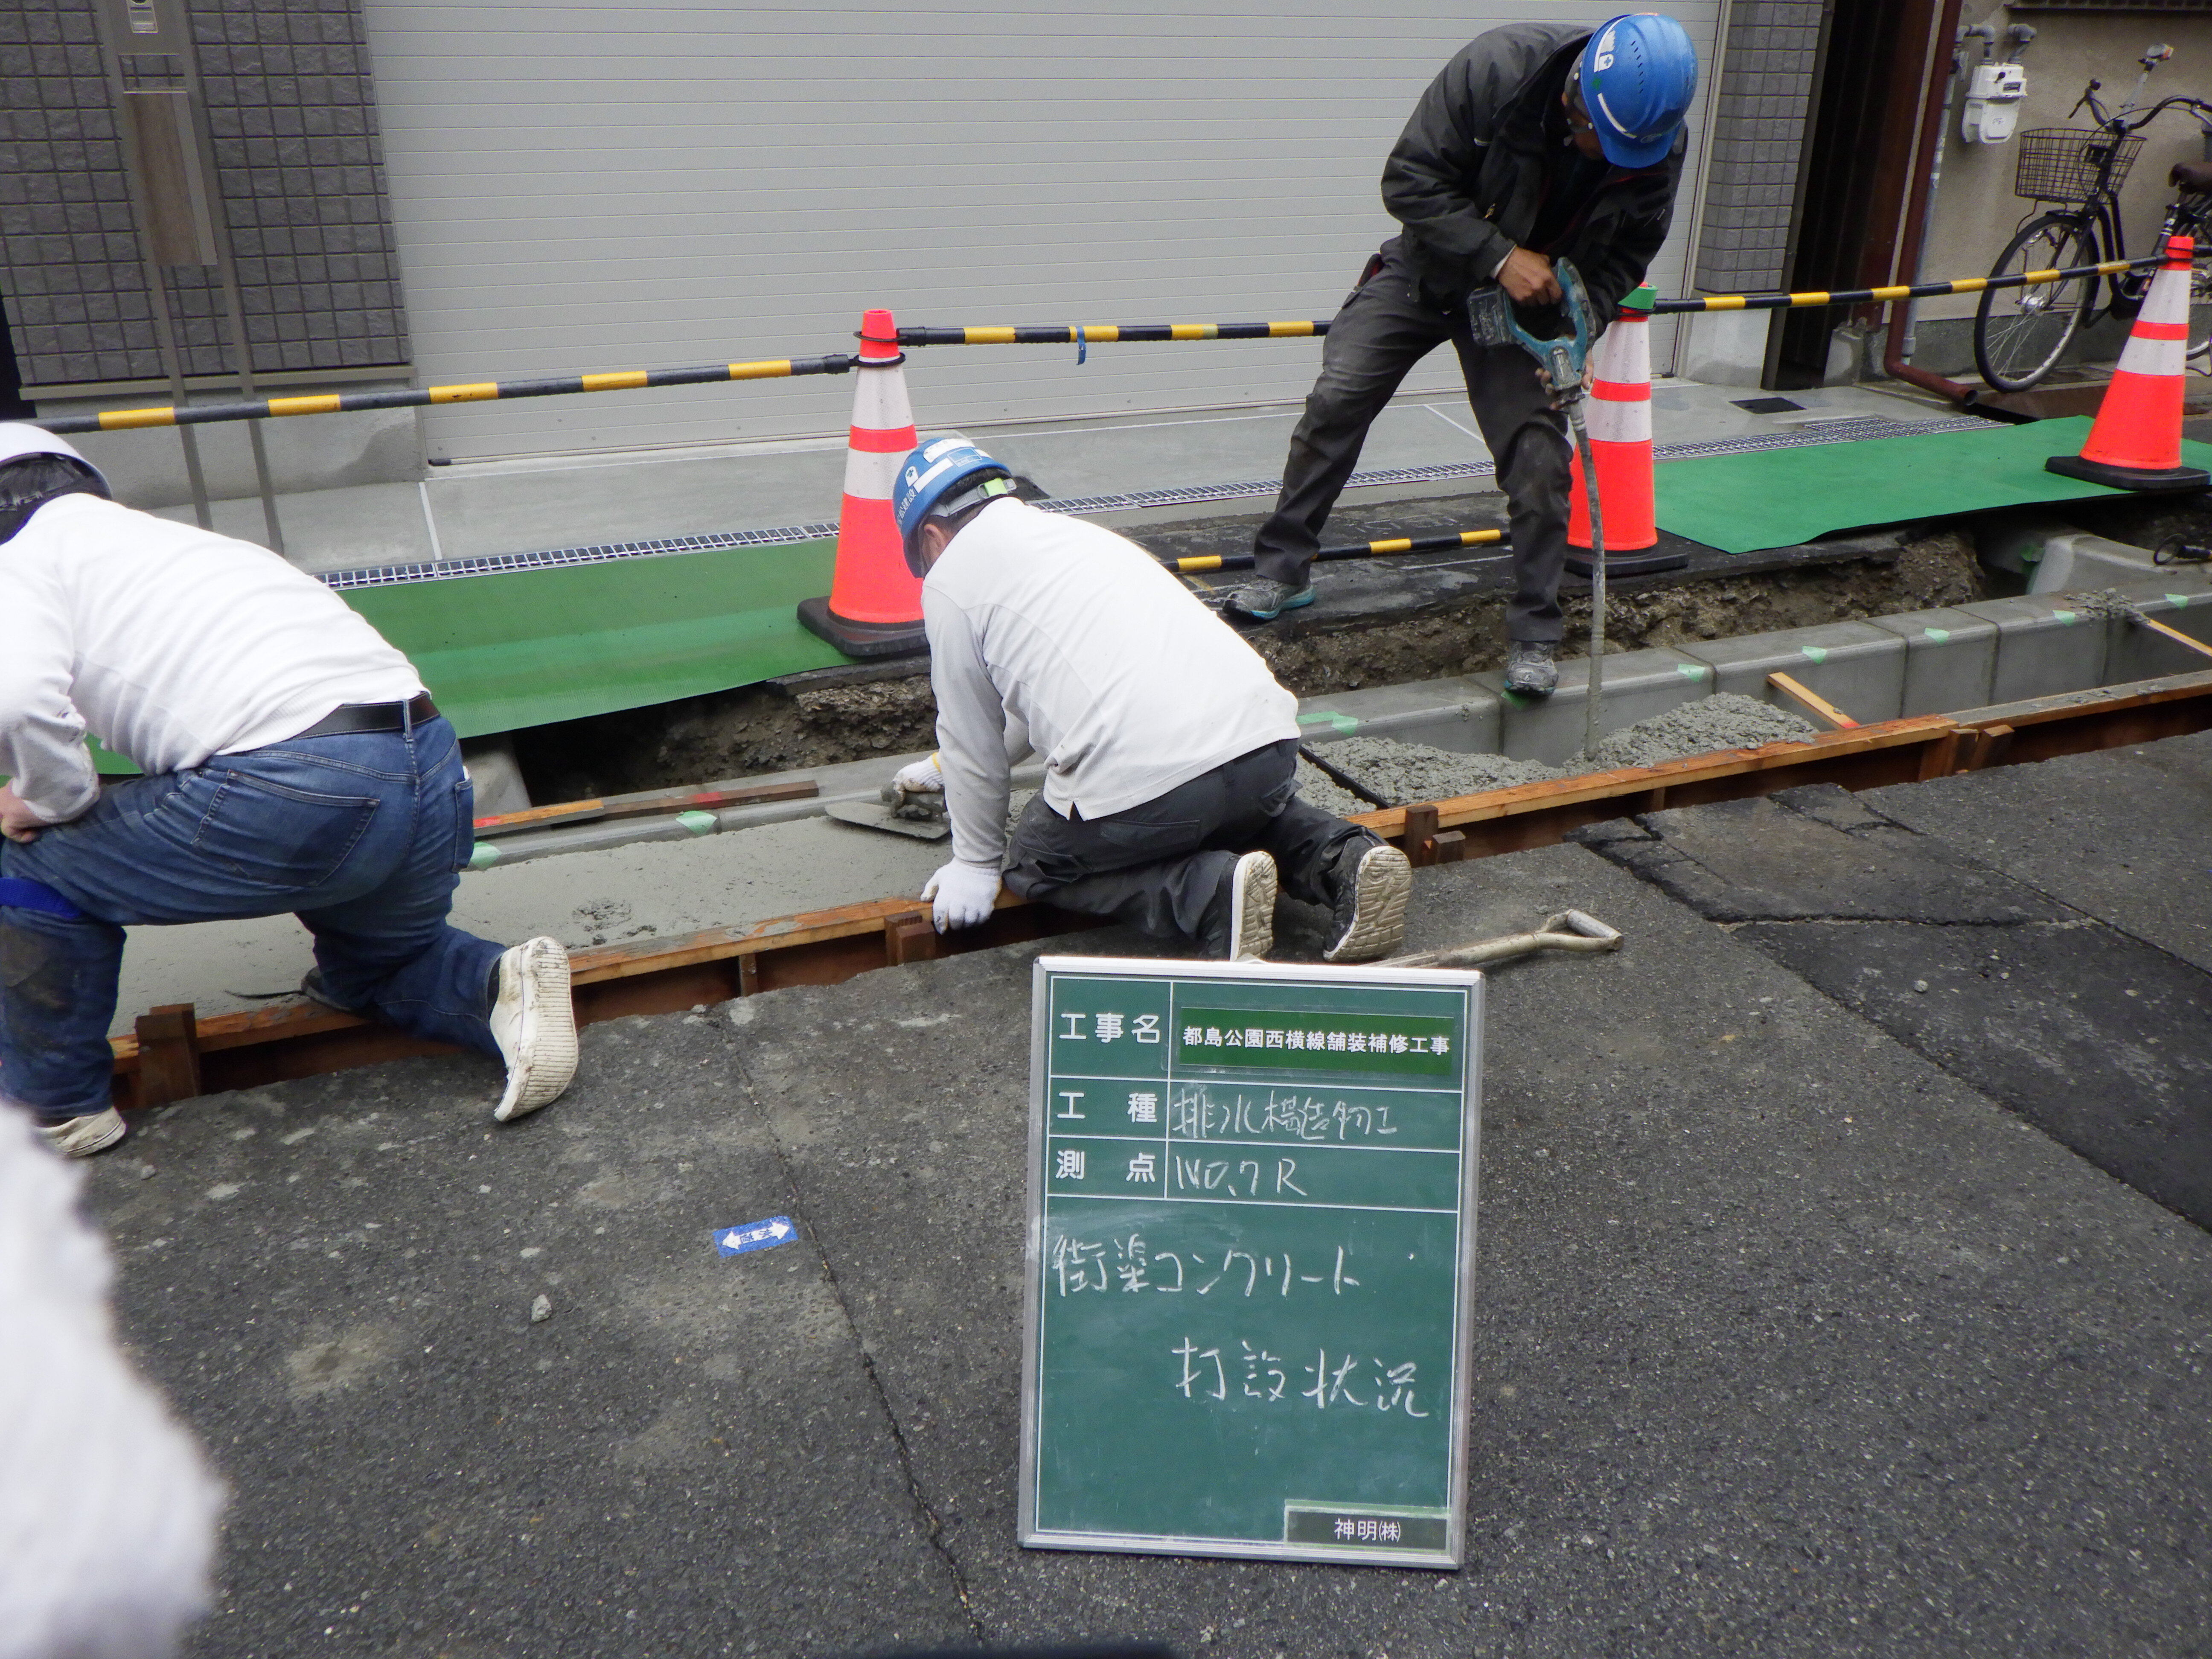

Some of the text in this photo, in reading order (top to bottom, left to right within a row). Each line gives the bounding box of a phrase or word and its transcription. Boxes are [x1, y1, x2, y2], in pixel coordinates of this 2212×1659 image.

[1059, 1013, 1160, 1043] 工事名
[1183, 1026, 1449, 1055] 都島公園西横線舗装補修工事
[1277, 1158, 1308, 1196] R
[1172, 1336, 1429, 1417] 打設状況
